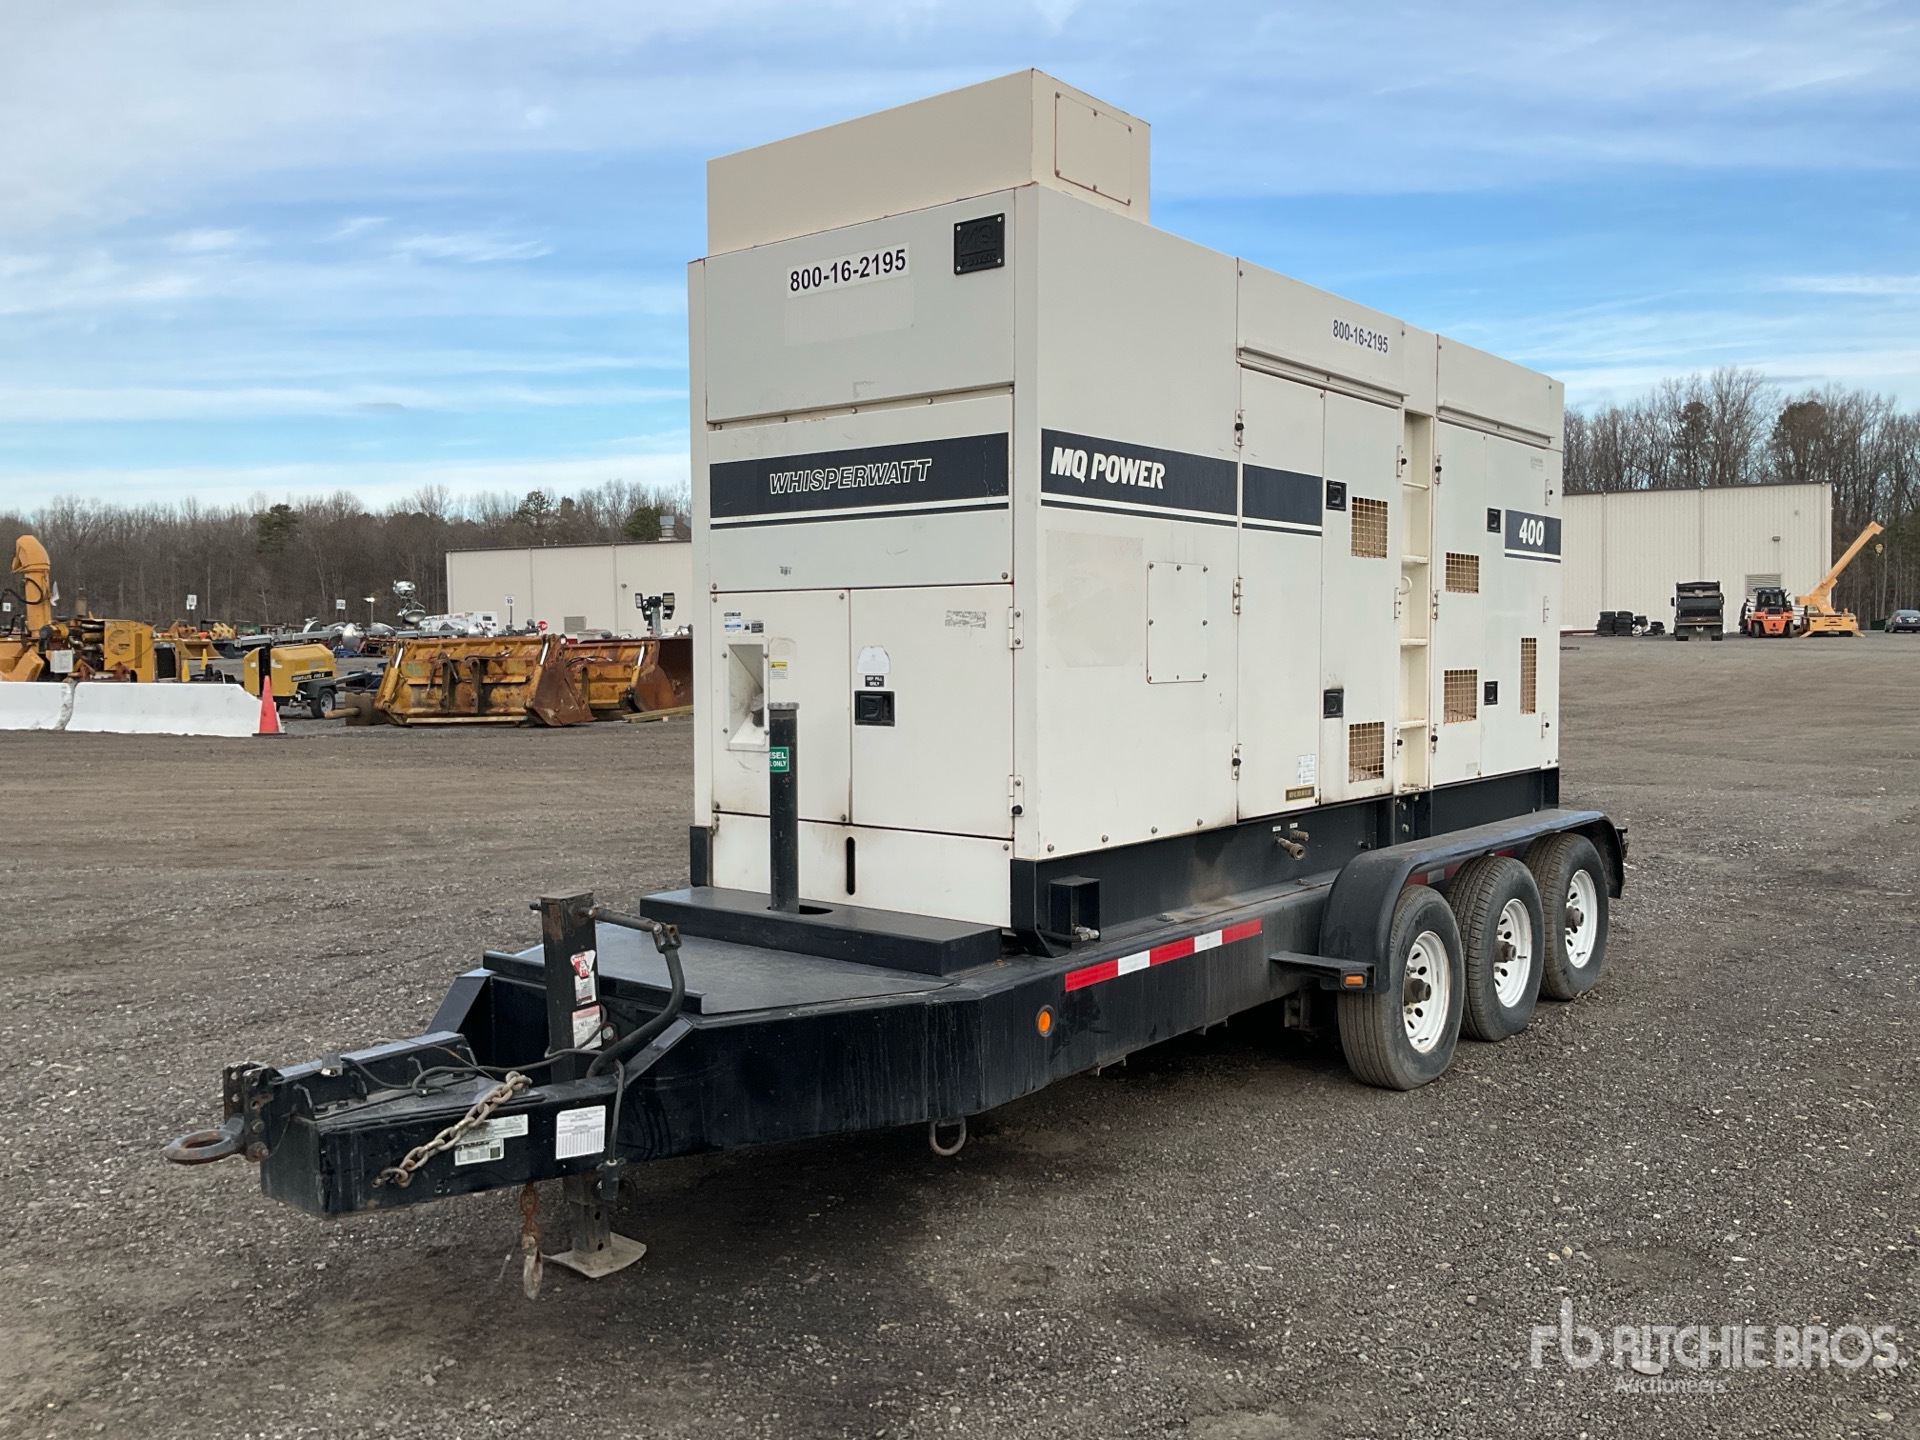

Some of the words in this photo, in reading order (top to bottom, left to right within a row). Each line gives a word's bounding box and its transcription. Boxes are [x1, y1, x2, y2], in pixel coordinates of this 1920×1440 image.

[790, 249, 906, 291] 800-16-2195
[1333, 319, 1388, 353] 800-16-2195
[770, 458, 932, 494] WHISPERWATT
[1050, 446, 1088, 483] MQ
[1090, 452, 1166, 490] POWER
[1519, 517, 1544, 547] 400
